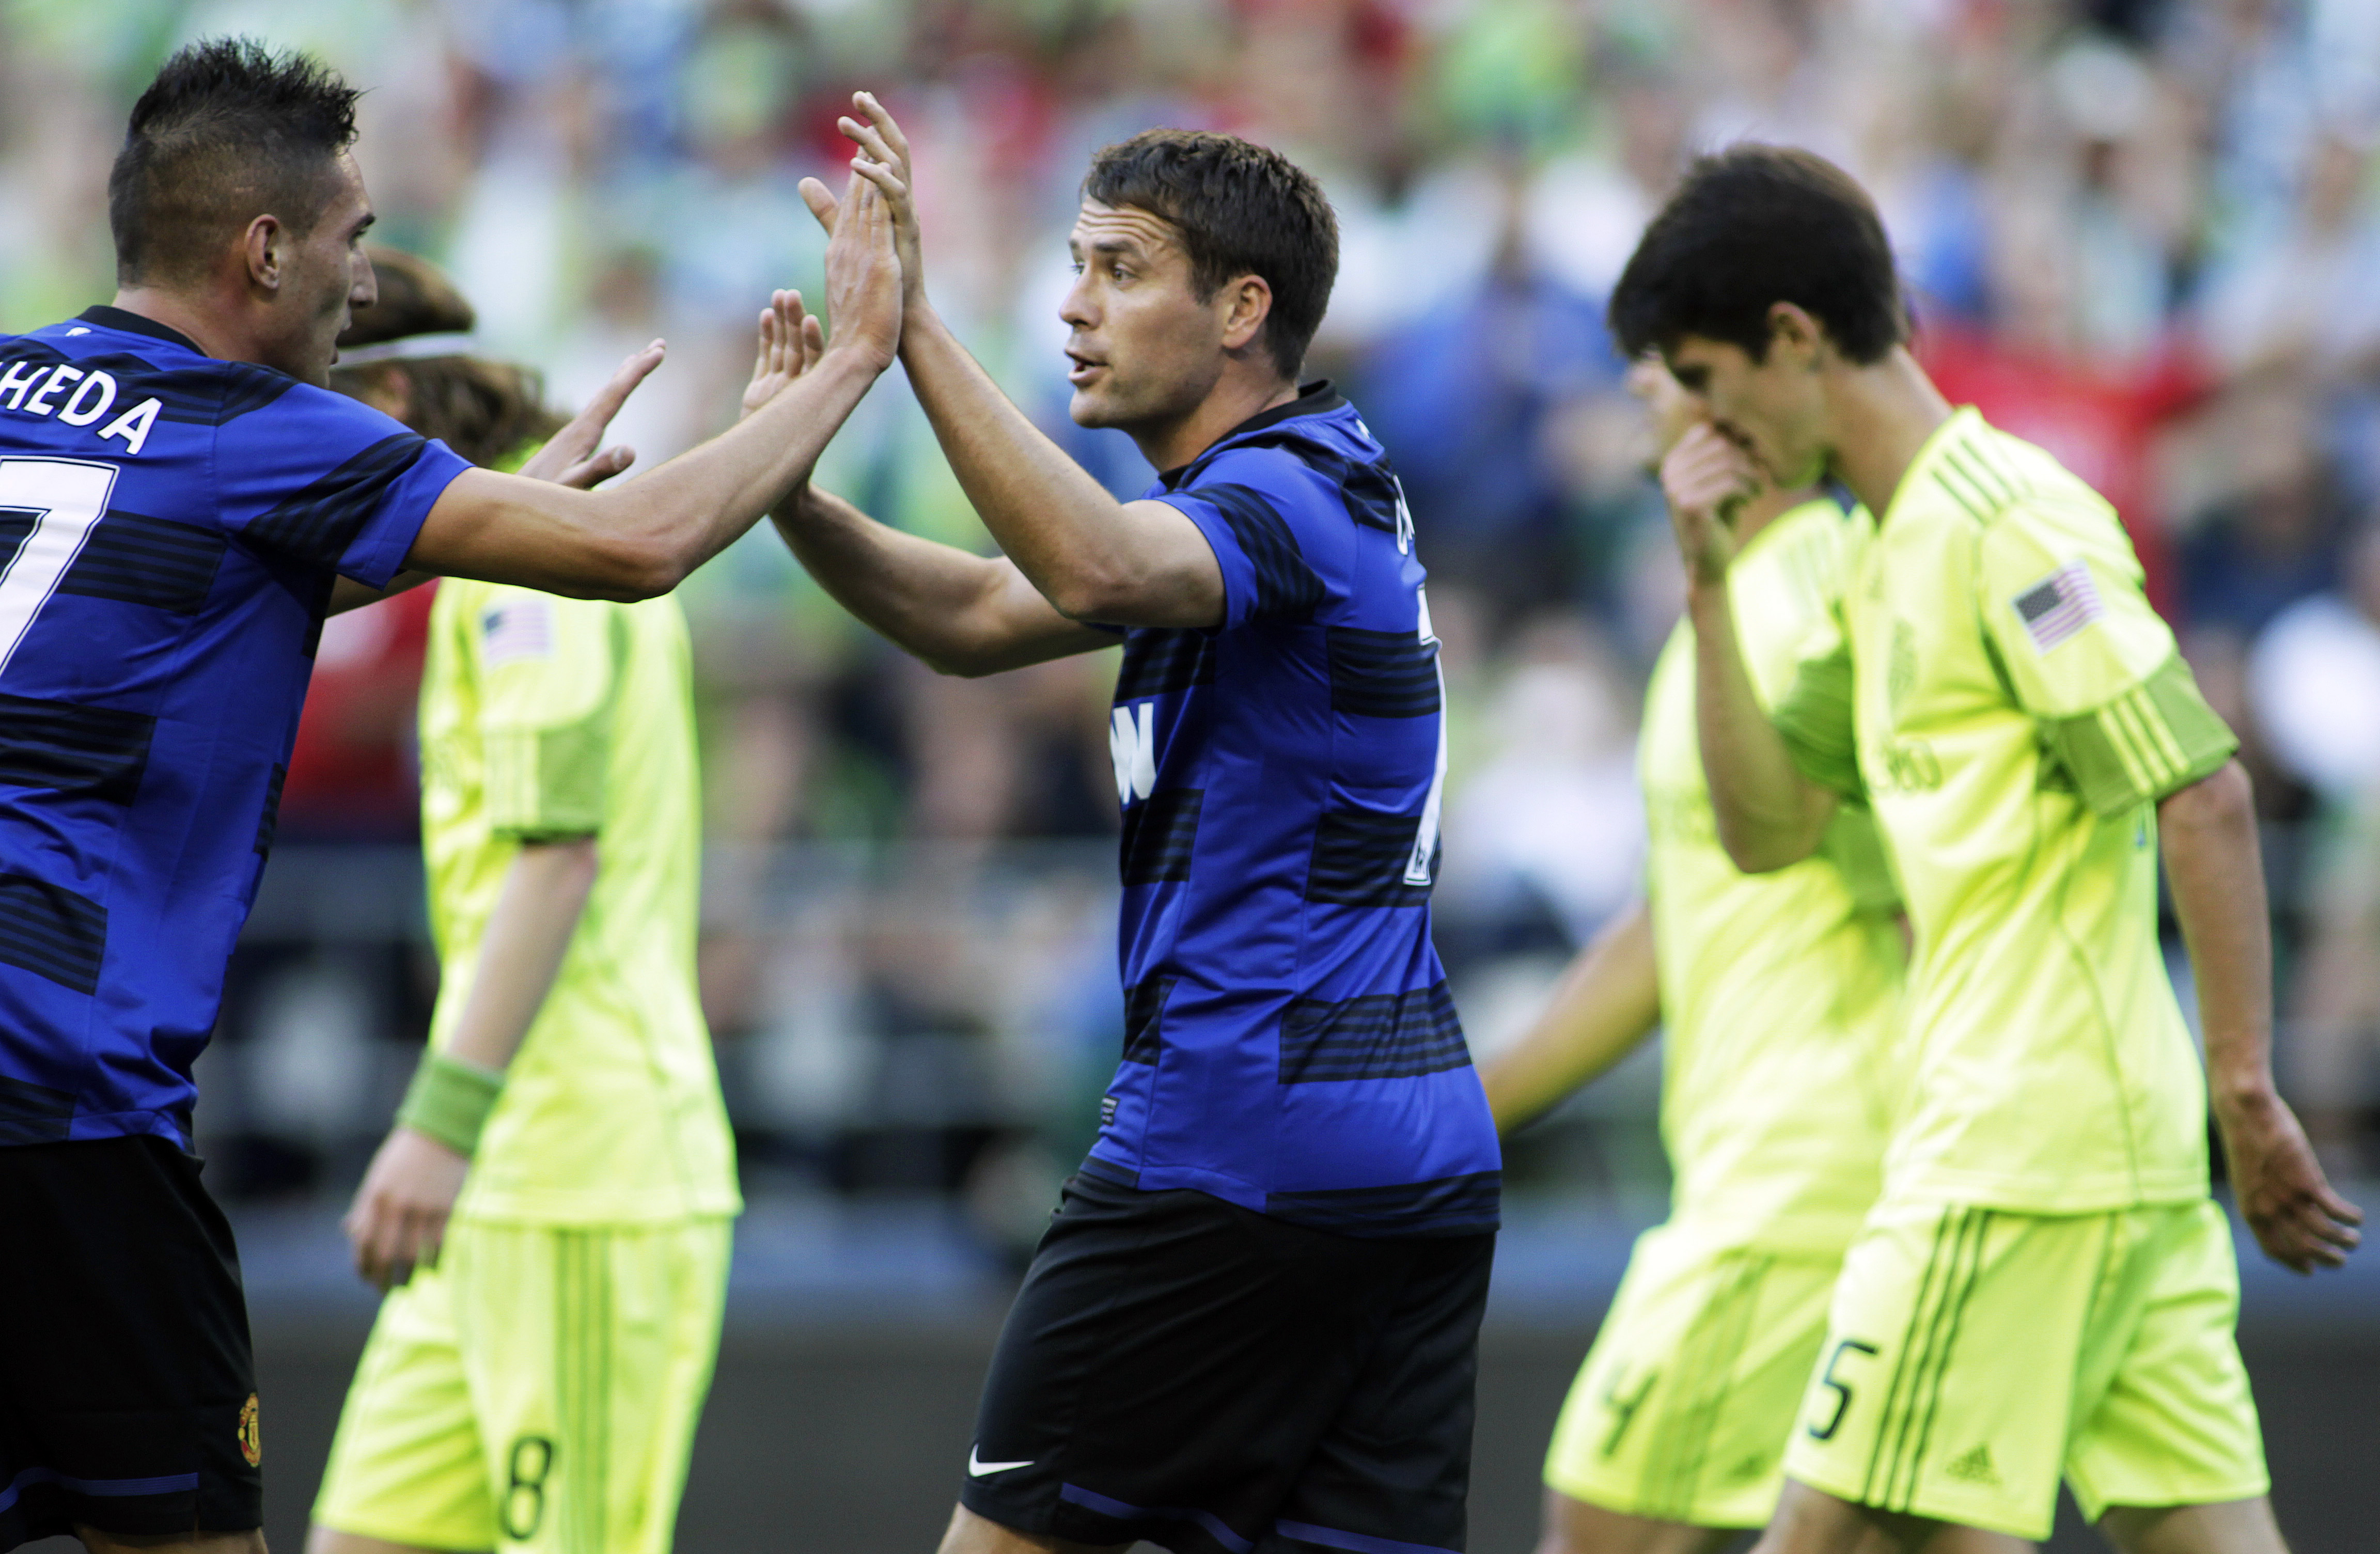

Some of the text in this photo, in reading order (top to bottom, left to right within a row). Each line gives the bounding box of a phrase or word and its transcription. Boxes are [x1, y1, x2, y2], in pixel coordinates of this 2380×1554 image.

[0, 360, 163, 455] HEDA
[1602, 1362, 1661, 1457] 4
[1808, 1339, 1878, 1441] 5
[498, 1434, 555, 1542] 8
